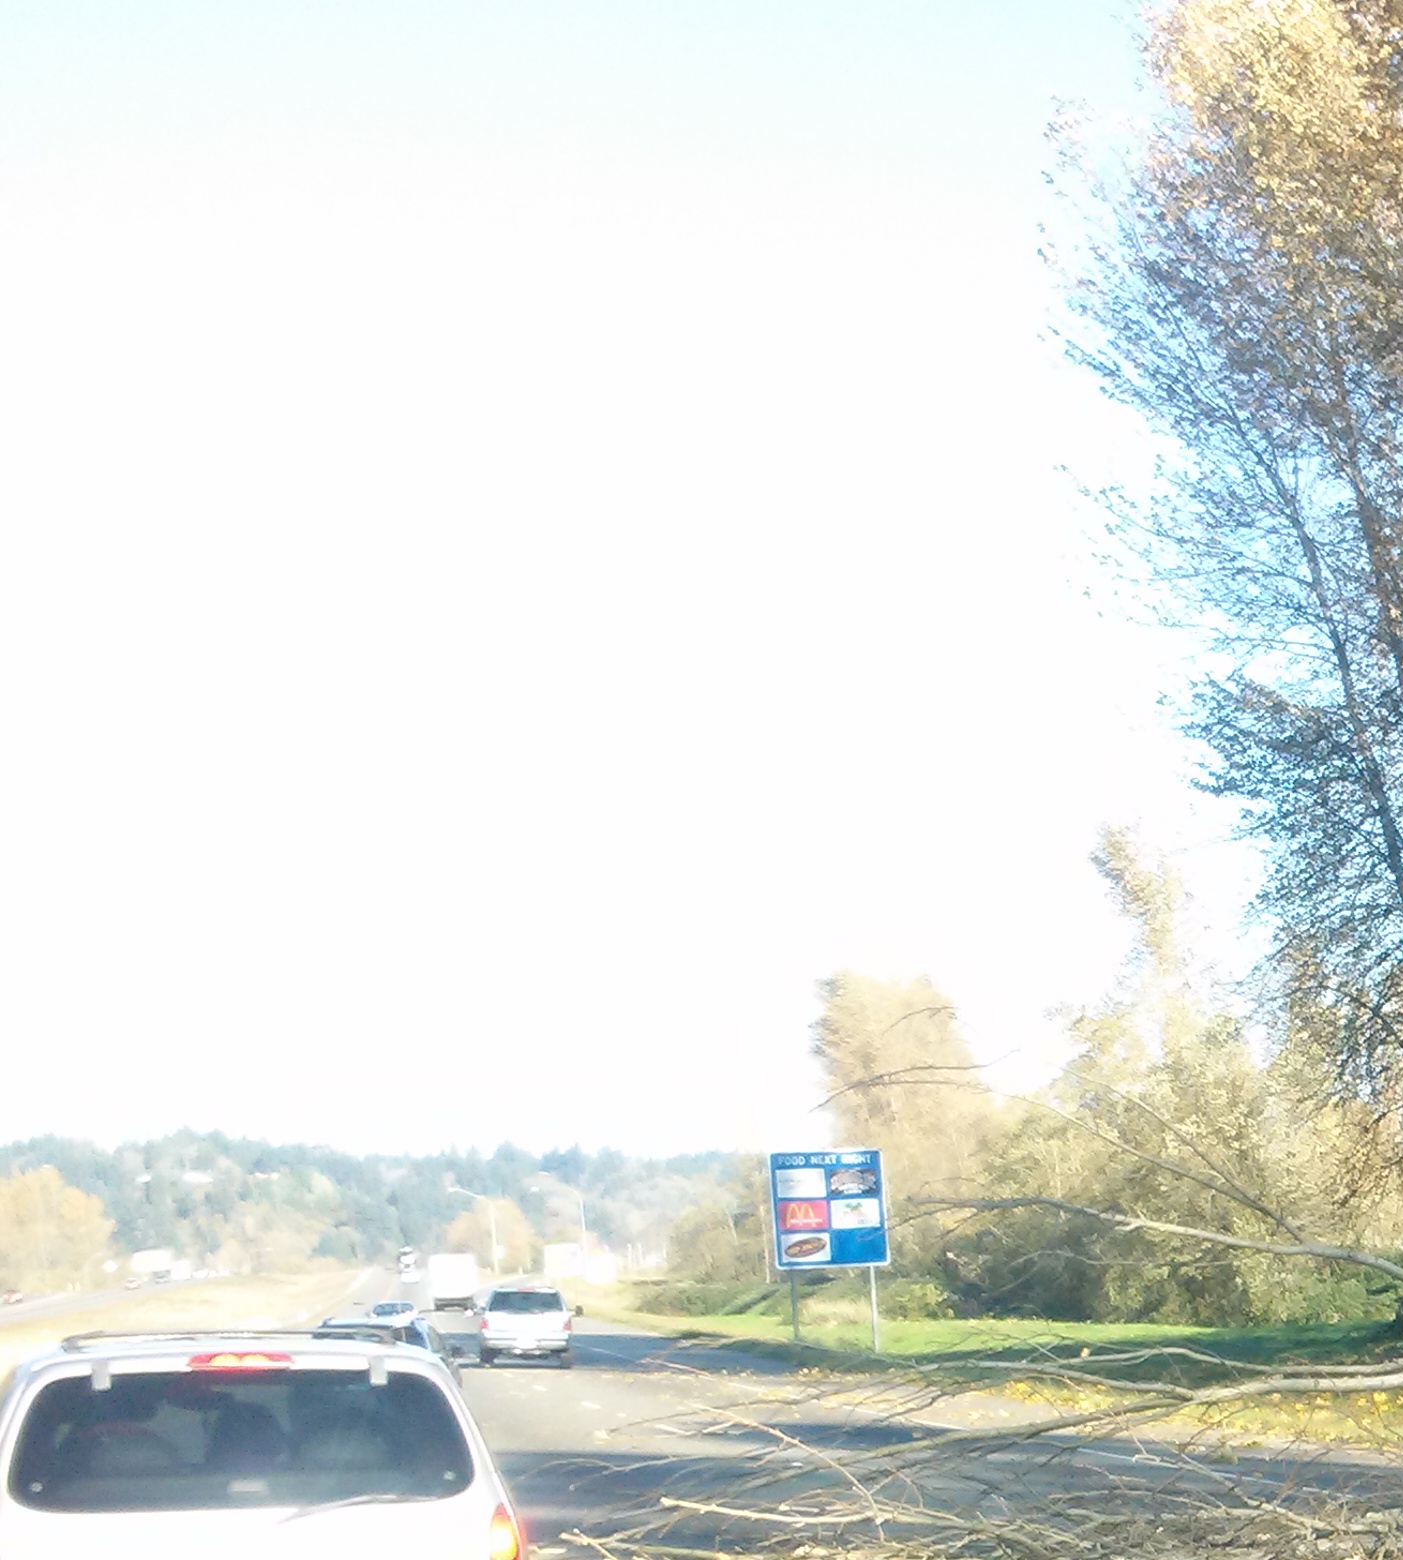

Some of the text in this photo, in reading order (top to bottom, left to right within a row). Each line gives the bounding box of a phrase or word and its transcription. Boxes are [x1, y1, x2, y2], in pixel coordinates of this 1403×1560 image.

[778, 1153, 871, 1165] FOOD NEXT RIGHT
